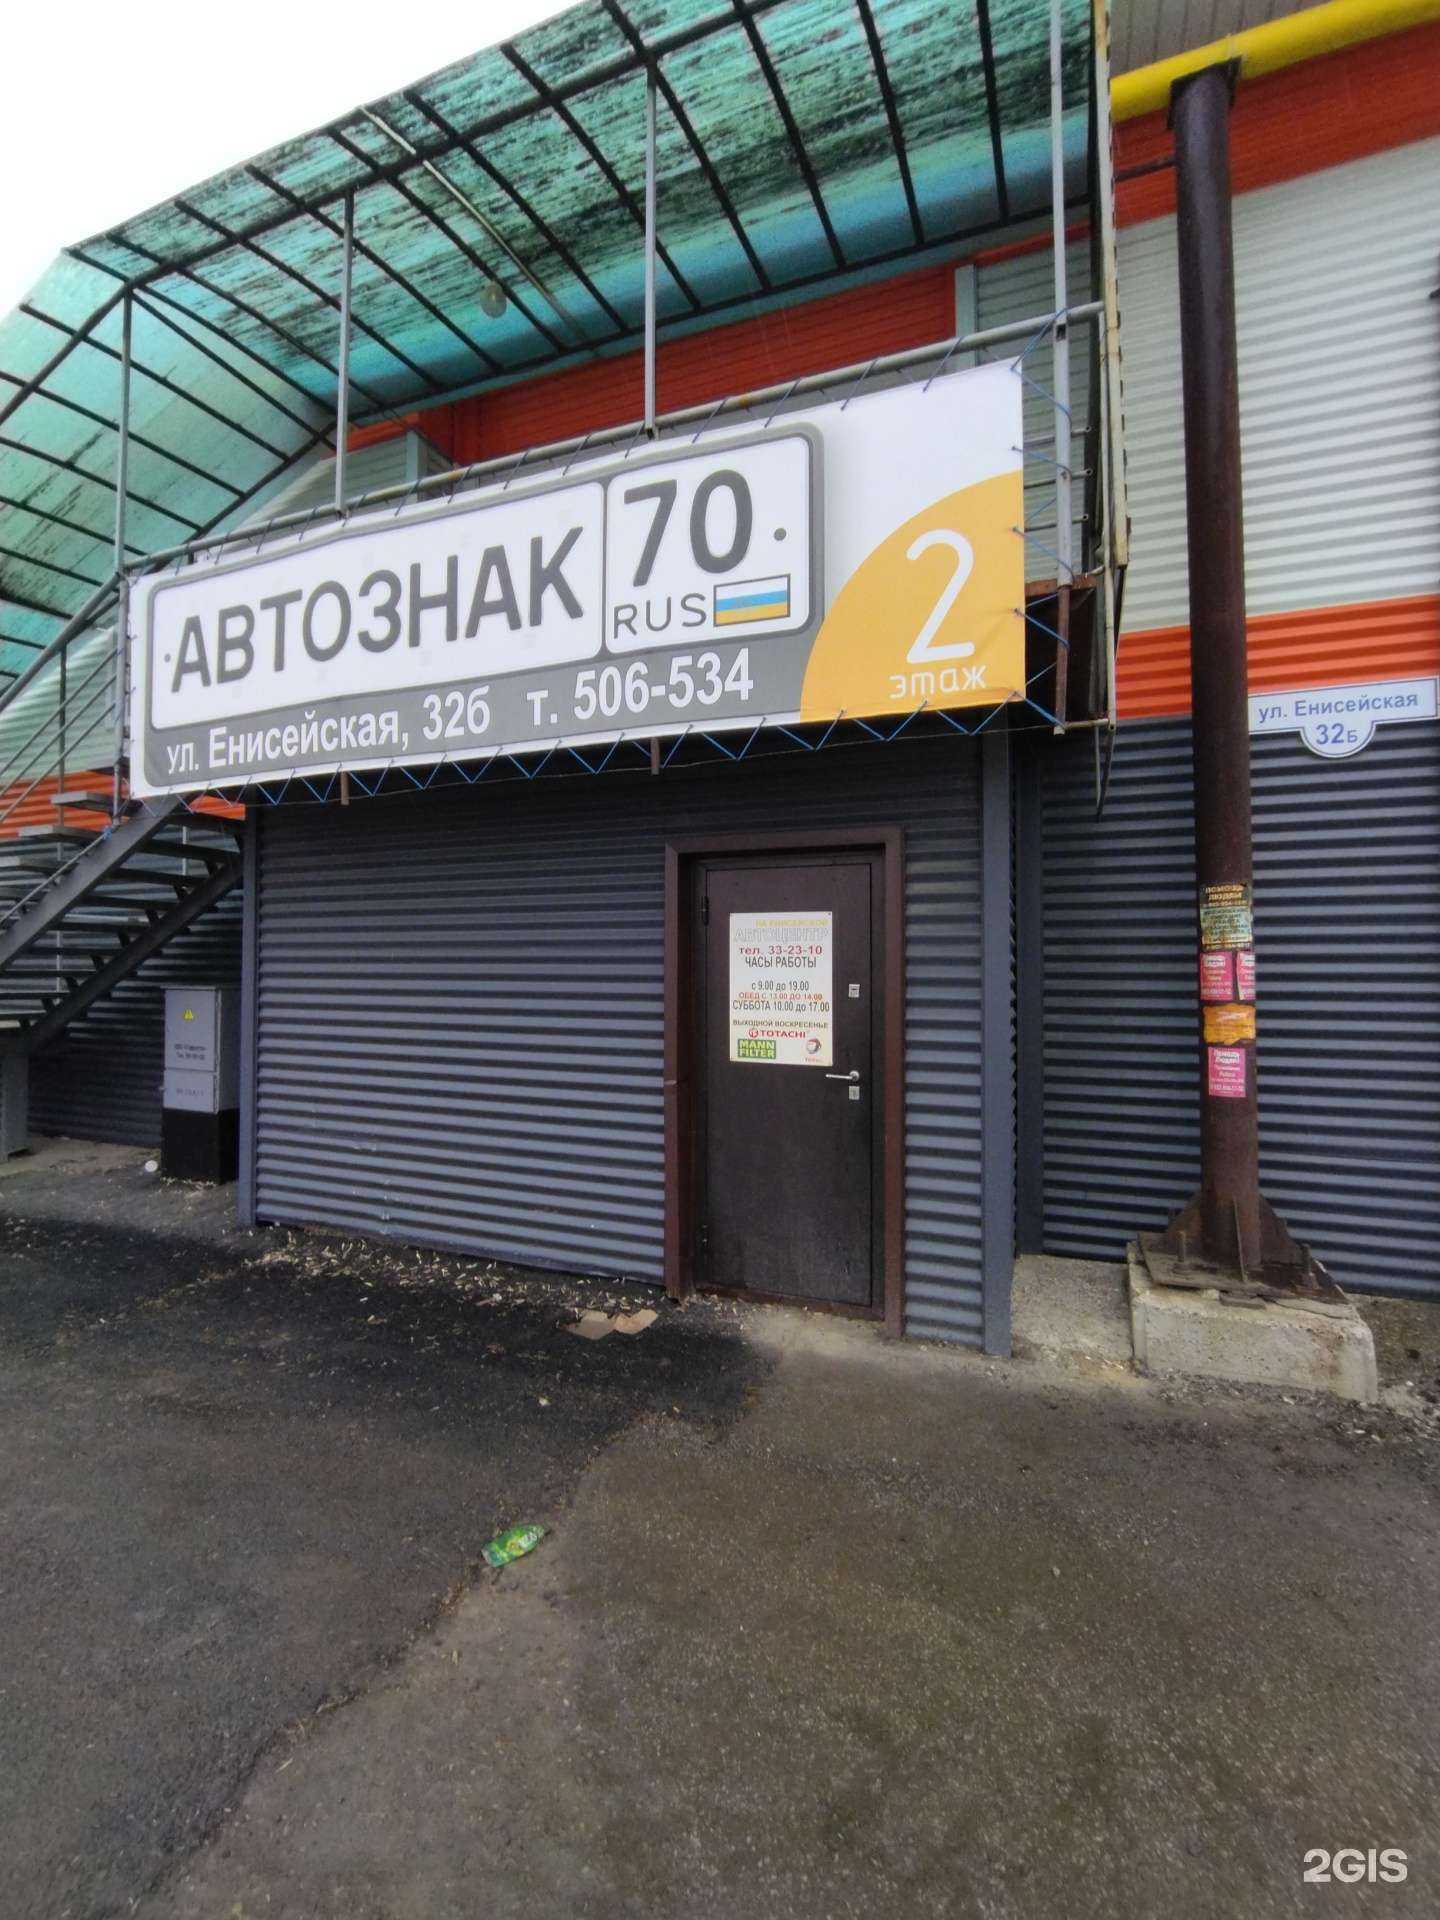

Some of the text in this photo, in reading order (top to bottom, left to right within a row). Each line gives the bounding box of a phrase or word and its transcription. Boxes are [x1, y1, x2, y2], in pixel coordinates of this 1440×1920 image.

[624, 469, 753, 587] 70
[906, 528, 974, 664] 2
[171, 526, 584, 693] АВТОЗНАК
[613, 592, 707, 640] RUS
[889, 665, 986, 699] этаж
[167, 648, 753, 775] ул. Енисейская, 32б т. 506-534
[1258, 694, 1419, 723] ул. Енисейская
[740, 945, 823, 955] тел. 33-23-10
[745, 956, 817, 968] ЧАСЫ РАБОТЫ
[776, 983, 786, 992] до
[733, 1000, 830, 1012] СУББОТА 10.00 до 17.00
[733, 1019, 773, 1027] ВЫХОДНОЙ
[760, 1030, 806, 1038] TOTACHI
[740, 1040, 775, 1049] MANN
[740, 1049, 775, 1058] FILTER
